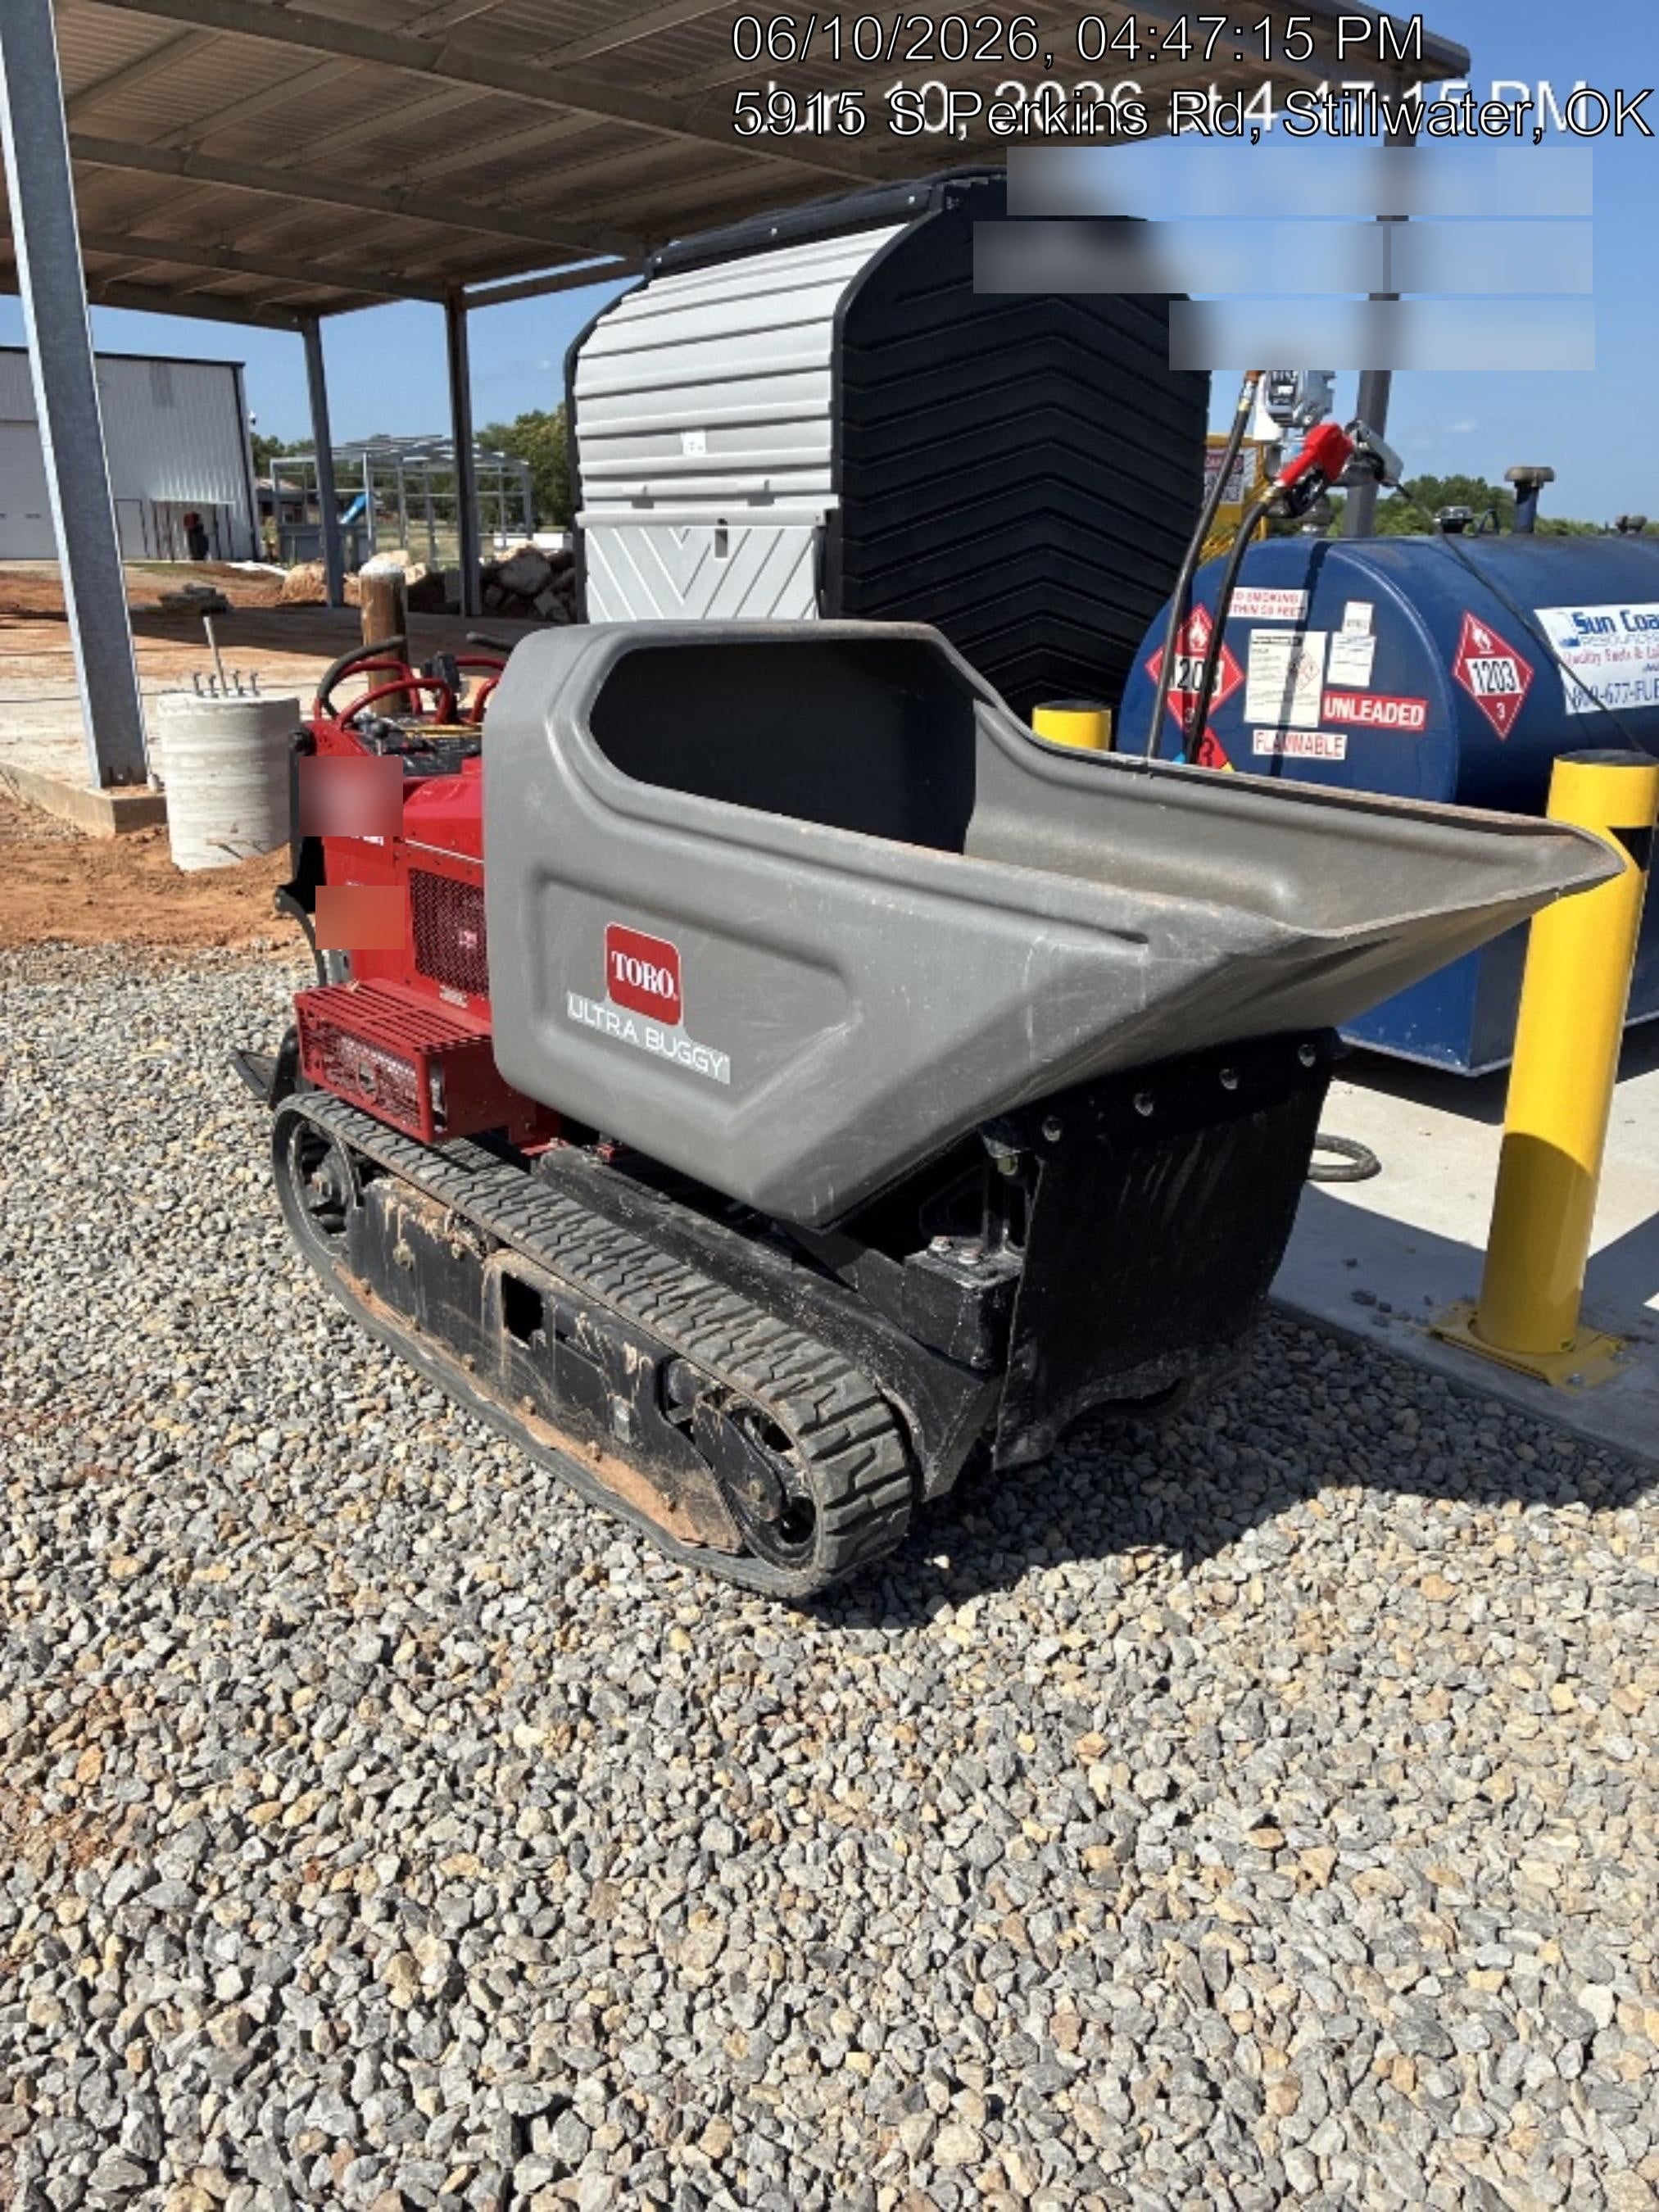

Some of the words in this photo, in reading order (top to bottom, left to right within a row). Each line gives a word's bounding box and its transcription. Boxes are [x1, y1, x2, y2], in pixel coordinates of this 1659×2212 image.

[1571, 611, 1616, 635] Sun
[1472, 660, 1516, 693] 1203
[1323, 695, 1426, 727] UNLEADED
[1496, 701, 1507, 722] 3
[1254, 732, 1344, 758] FLAMMABLE
[611, 950, 676, 999] TORO
[569, 993, 640, 1044] ULTRA
[646, 1026, 724, 1077] BUGGY
